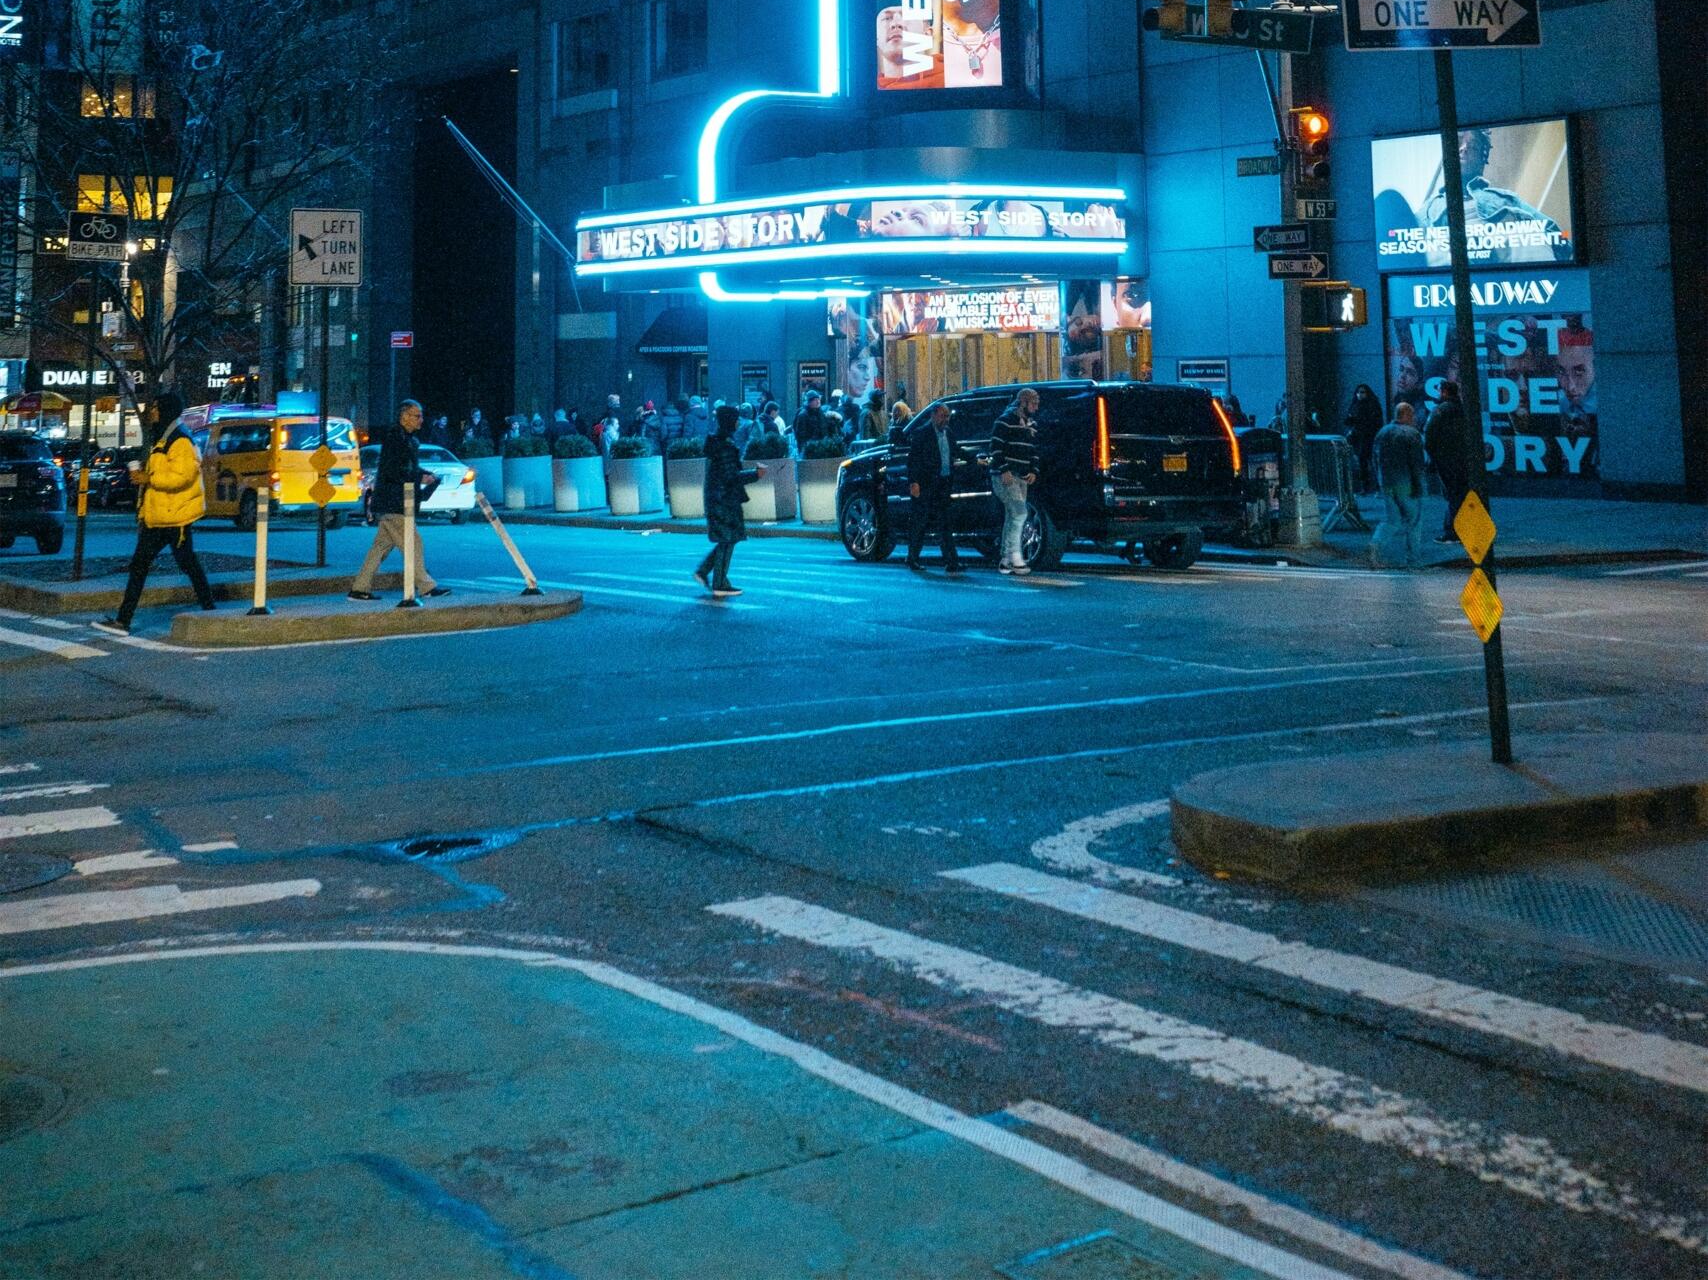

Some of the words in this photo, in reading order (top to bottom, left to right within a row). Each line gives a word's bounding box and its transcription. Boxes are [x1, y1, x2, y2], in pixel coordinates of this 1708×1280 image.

[1374, 0, 1430, 27] ONE
[1454, 0, 1509, 26] WAY
[1259, 18, 1285, 42] St
[1307, 202, 1314, 218] W
[1316, 202, 1326, 218] 53
[929, 210, 992, 225] WEST
[997, 211, 1043, 226] SIDE
[1048, 212, 1109, 227] STORY
[322, 220, 356, 234] LEFT
[1426, 226, 1450, 240] NE
[1465, 219, 1548, 237] BROADWAY
[600, 228, 659, 259] WEST
[665, 222, 721, 252] SIDE
[727, 212, 814, 248] STORY
[1263, 233, 1280, 243] ONE
[1285, 231, 1301, 242] WAY
[1467, 235, 1506, 249] AJOR
[71, 244, 93, 256] BIKE
[99, 245, 124, 258] PATH
[321, 240, 357, 255] TURN
[321, 261, 355, 275] LANE
[1277, 261, 1295, 272] ONE
[1302, 261, 1319, 271] WAY
[945, 292, 1005, 306] EXPLOSION
[1006, 291, 1022, 303] OF
[990, 304, 1016, 315] IDEA
[1017, 303, 1033, 315] OF
[1035, 302, 1059, 314] WHA
[955, 315, 1002, 329] MUSICAL
[1004, 315, 1028, 327] CAN
[1409, 319, 1567, 357] WEST
[1424, 376, 1561, 414] SDE
[1484, 435, 1591, 474] ORY
